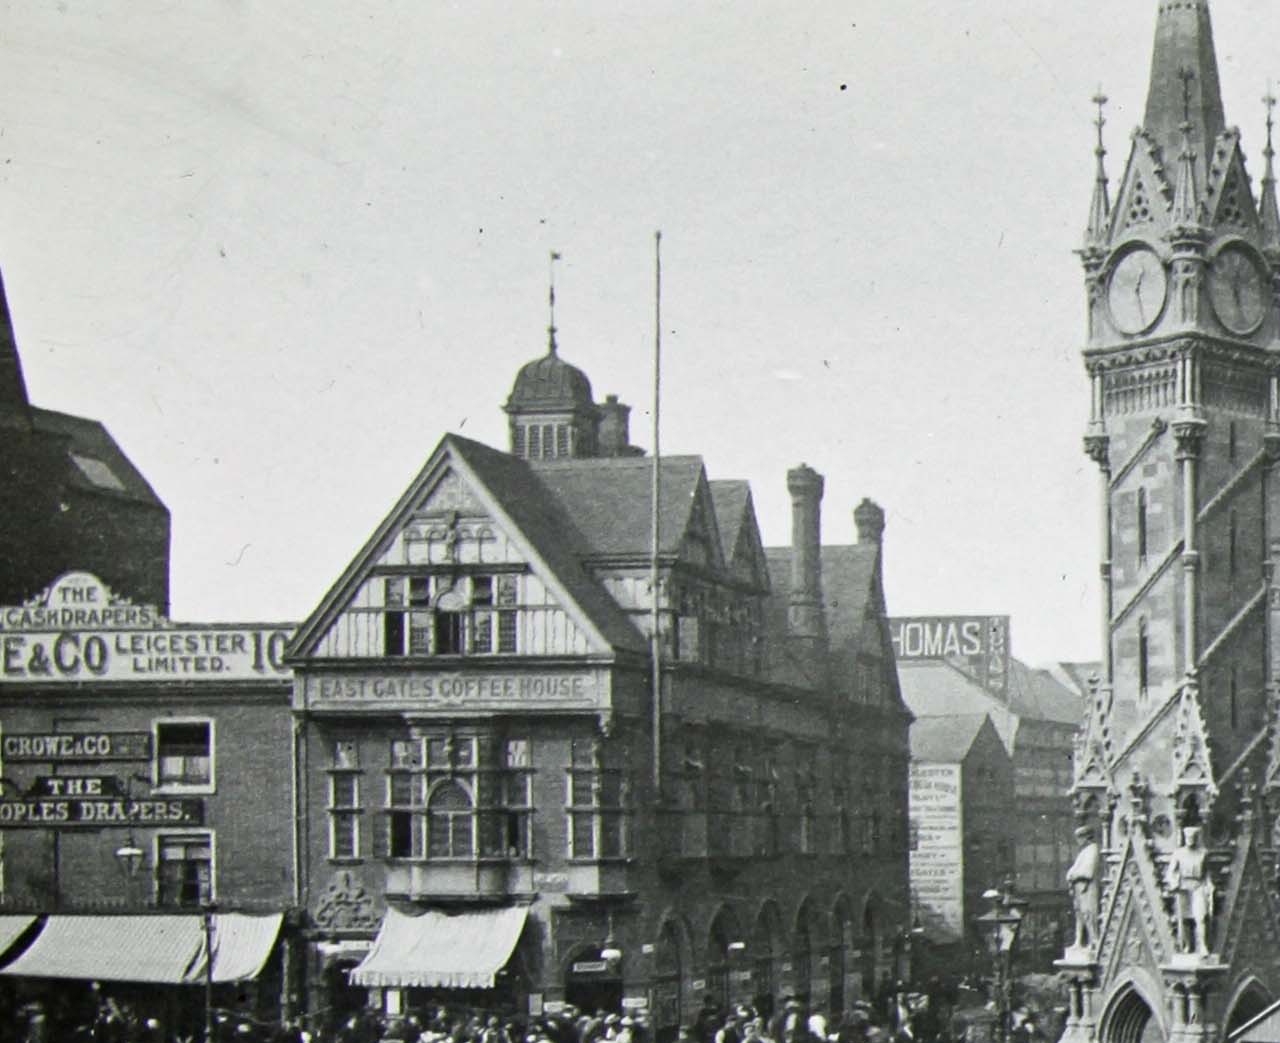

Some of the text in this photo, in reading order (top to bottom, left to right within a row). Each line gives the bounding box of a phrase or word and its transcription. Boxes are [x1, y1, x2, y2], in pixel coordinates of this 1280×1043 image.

[60, 585, 97, 603] THE
[115, 634, 247, 655] LEICESTER
[132, 656, 231, 673] LIMITED.
[320, 676, 584, 699] EAST GATES COFFEE HOUSE
[48, 779, 102, 795] THE
